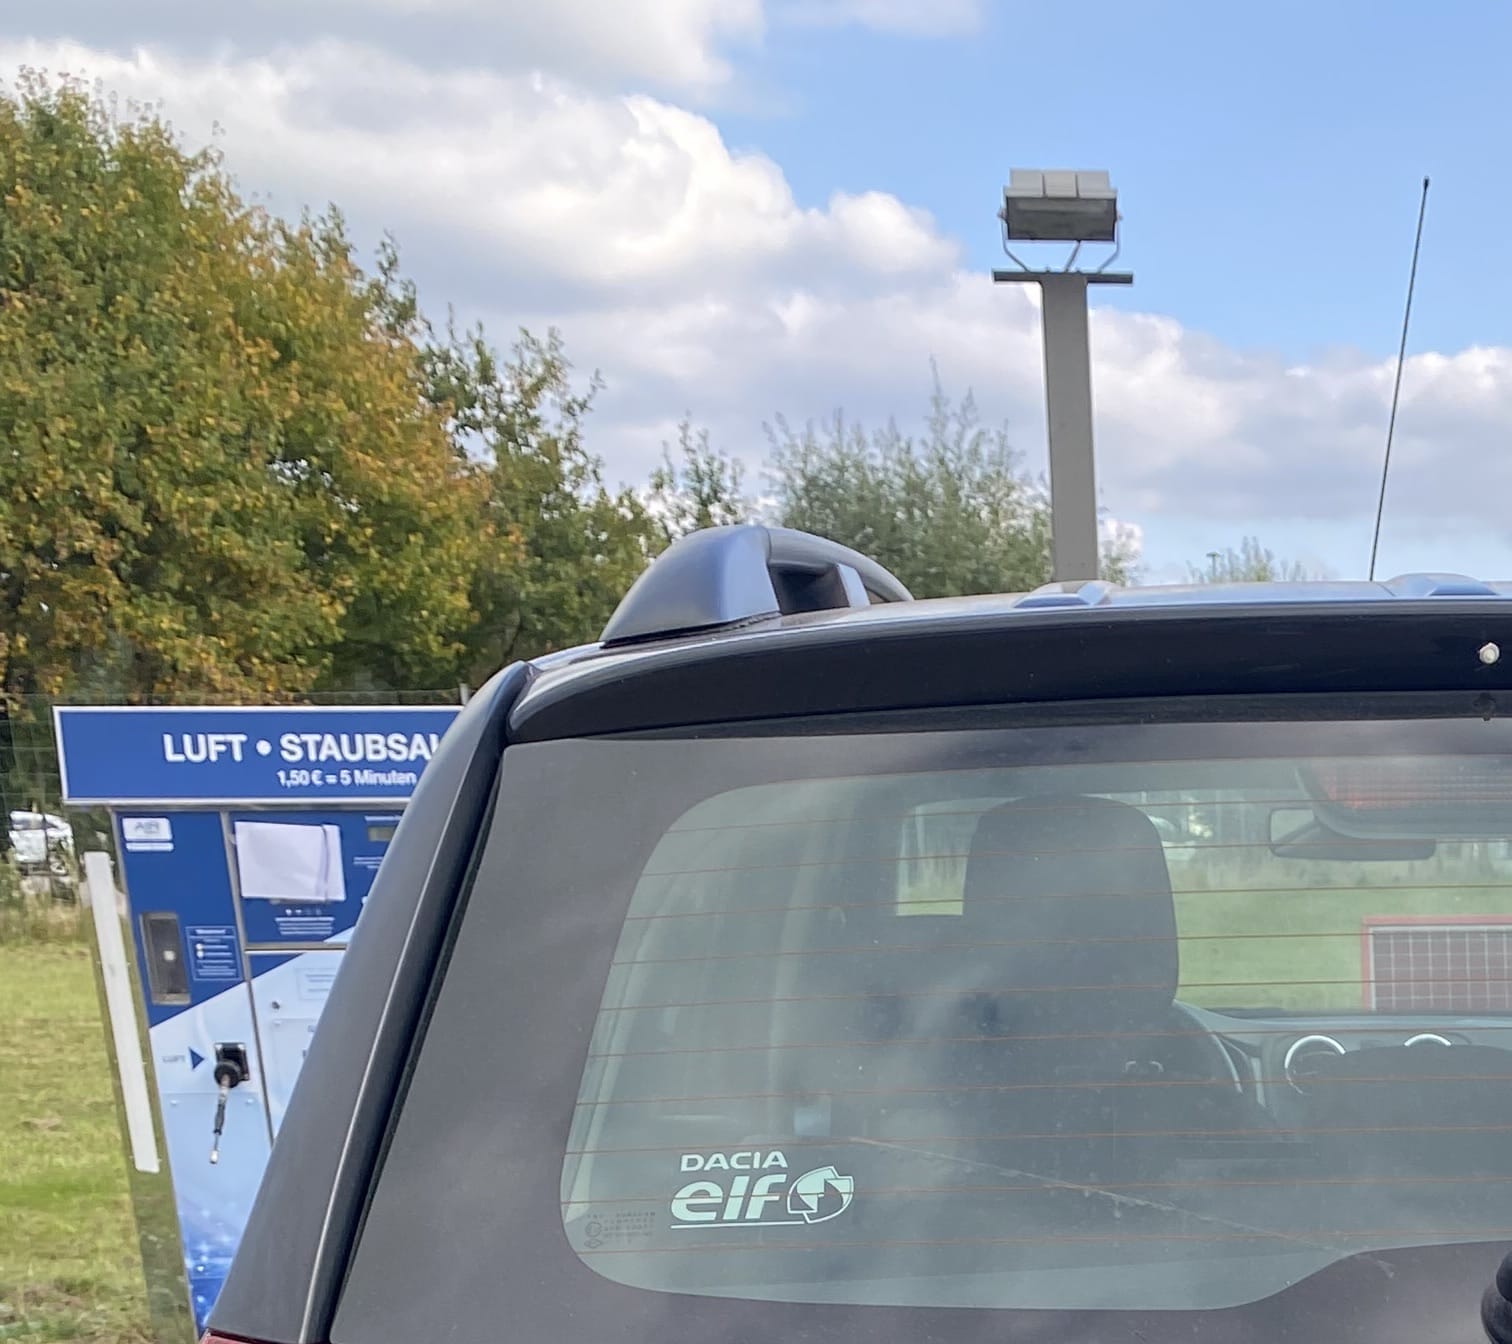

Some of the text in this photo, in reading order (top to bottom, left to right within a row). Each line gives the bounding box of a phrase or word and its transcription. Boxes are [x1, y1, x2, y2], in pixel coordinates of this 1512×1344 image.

[163, 733, 248, 762] LUFT
[340, 770, 351, 785] 5
[354, 769, 417, 786] Minuten
[680, 1151, 788, 1172] DACIA
[670, 1173, 787, 1221] elf
